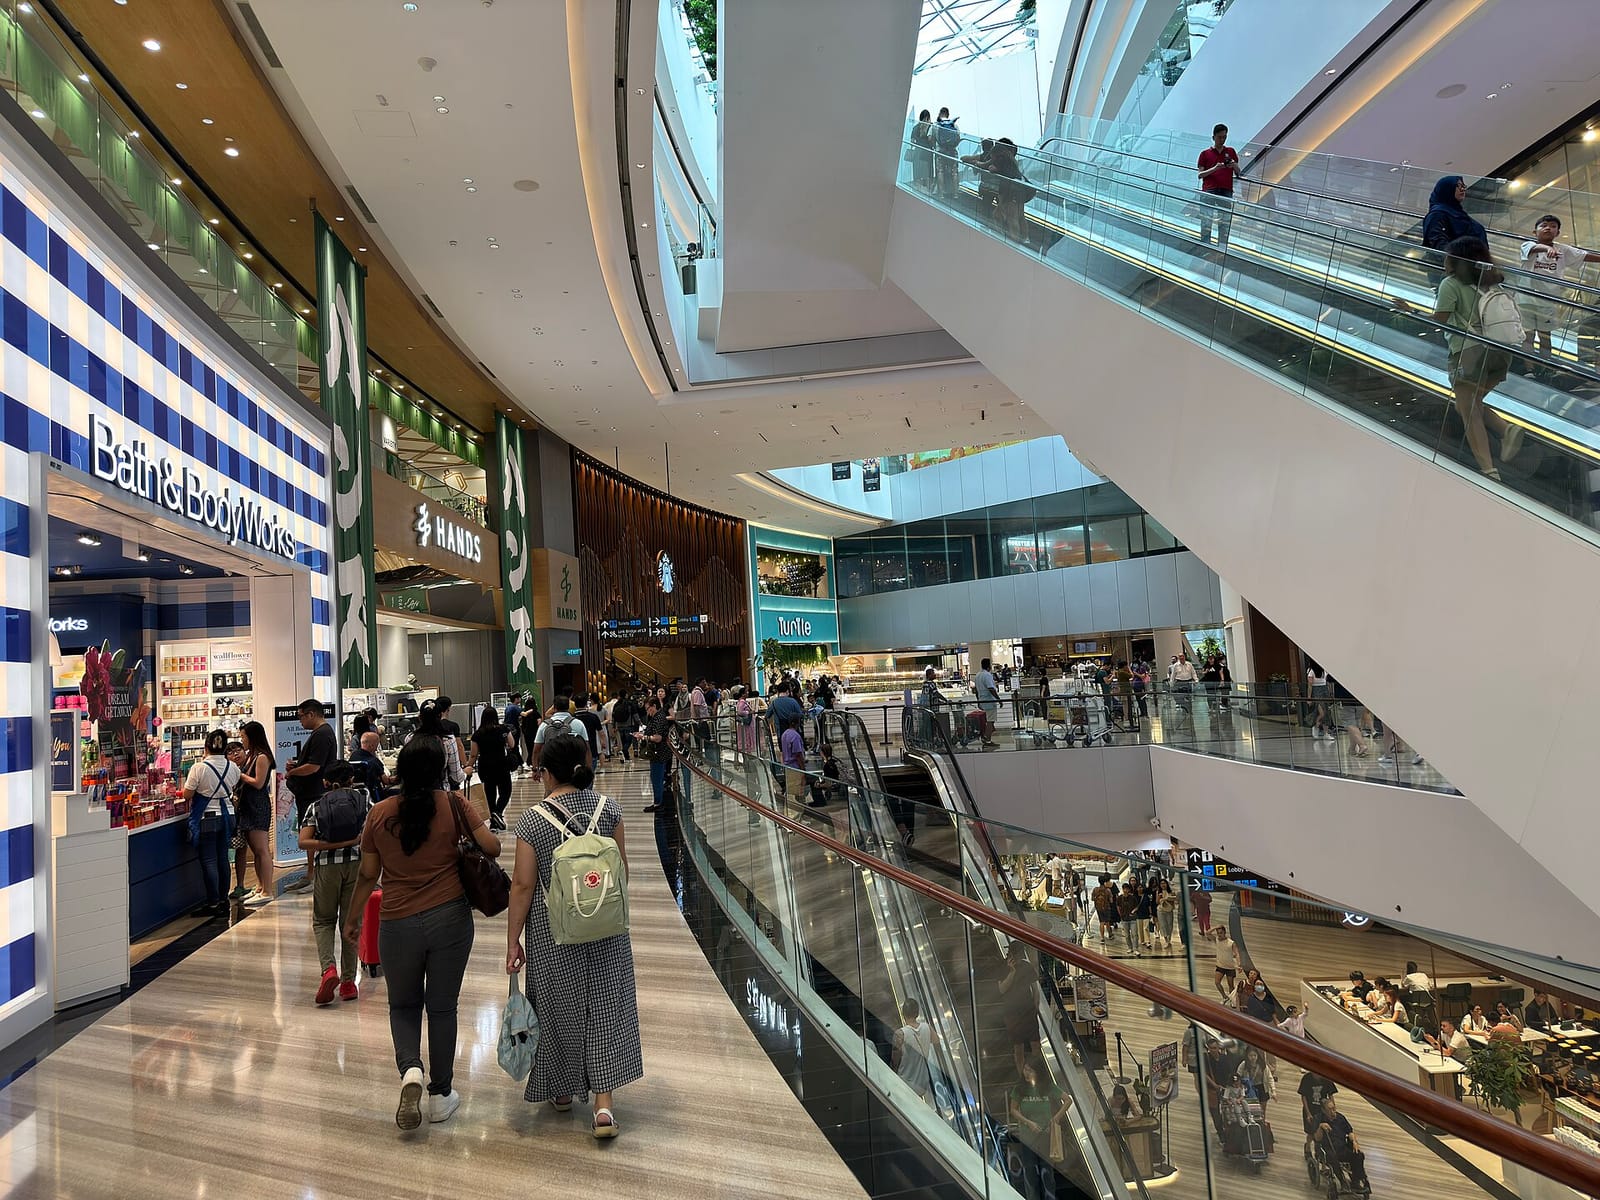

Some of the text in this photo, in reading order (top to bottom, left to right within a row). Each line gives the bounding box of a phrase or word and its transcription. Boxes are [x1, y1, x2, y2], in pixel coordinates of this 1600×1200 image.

[88, 413, 296, 560] Bath & Body Works
[432, 515, 481, 563] HANDS
[556, 607, 577, 621] HANDS
[107, 693, 130, 705] DREAM
[104, 705, 133, 719] GETAWAY
[278, 710, 297, 718] FIRST
